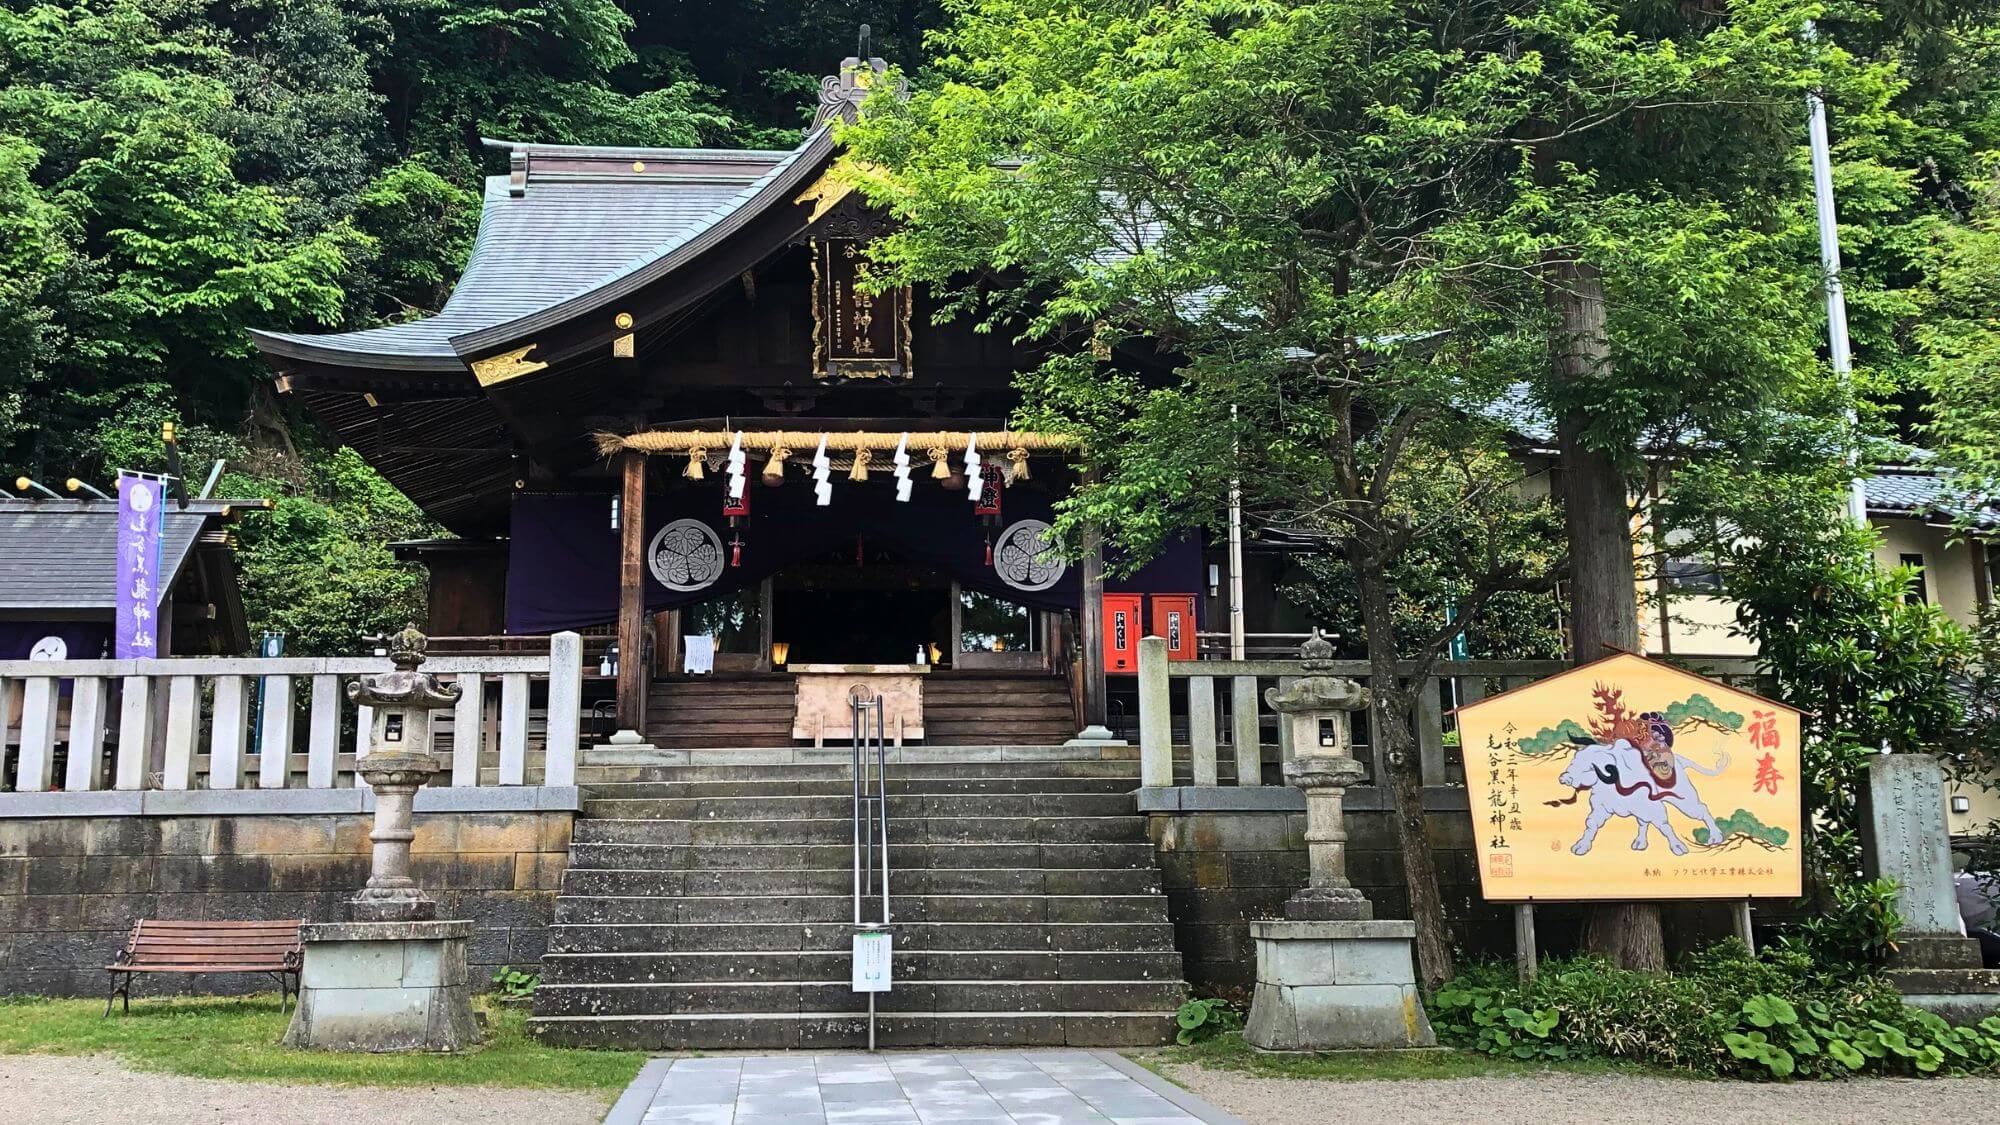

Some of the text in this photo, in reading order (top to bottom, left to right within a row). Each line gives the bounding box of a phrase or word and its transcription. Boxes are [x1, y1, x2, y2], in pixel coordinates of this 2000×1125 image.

[1116, 612, 1126, 649] おみくじ
[1169, 612, 1179, 650] おみくじ
[1486, 733, 1510, 849] 毛谷黒龍神社
[1501, 721, 1523, 831] 令和三年辛丑歳
[1747, 710, 1785, 796] 福寿
